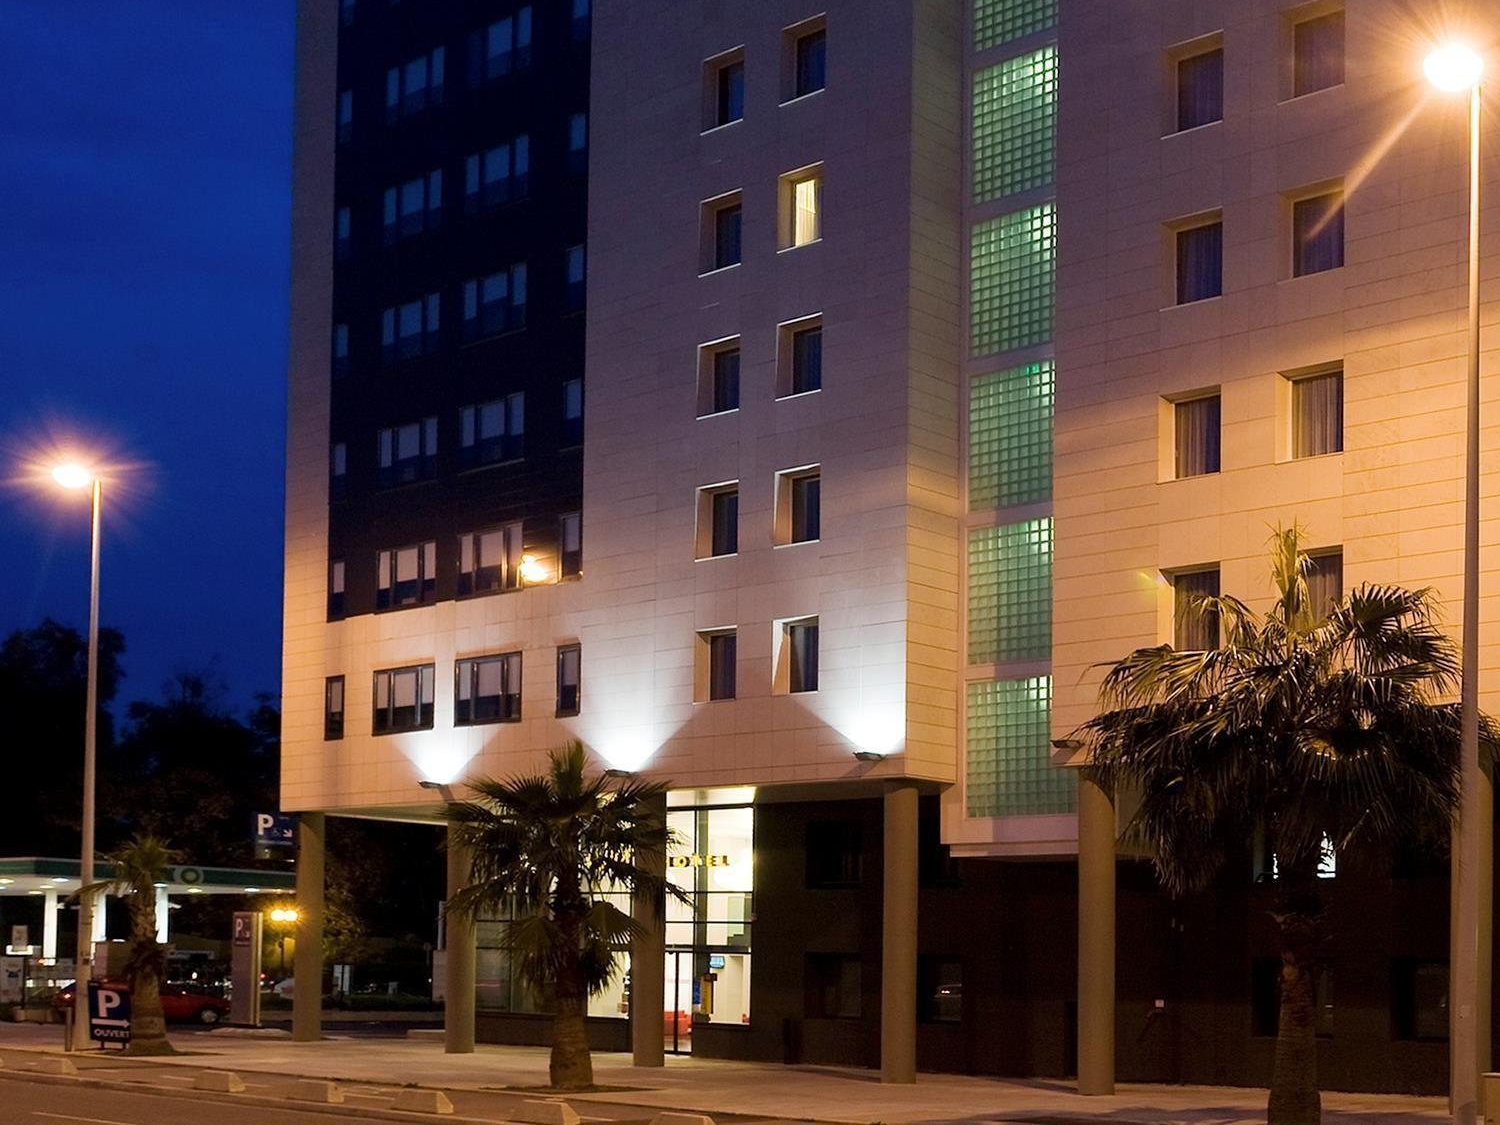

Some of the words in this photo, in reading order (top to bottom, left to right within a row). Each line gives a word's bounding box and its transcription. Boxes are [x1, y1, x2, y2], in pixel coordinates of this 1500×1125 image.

[257, 814, 274, 836] P
[97, 989, 121, 1018] P
[93, 1028, 130, 1038] OUVERT
